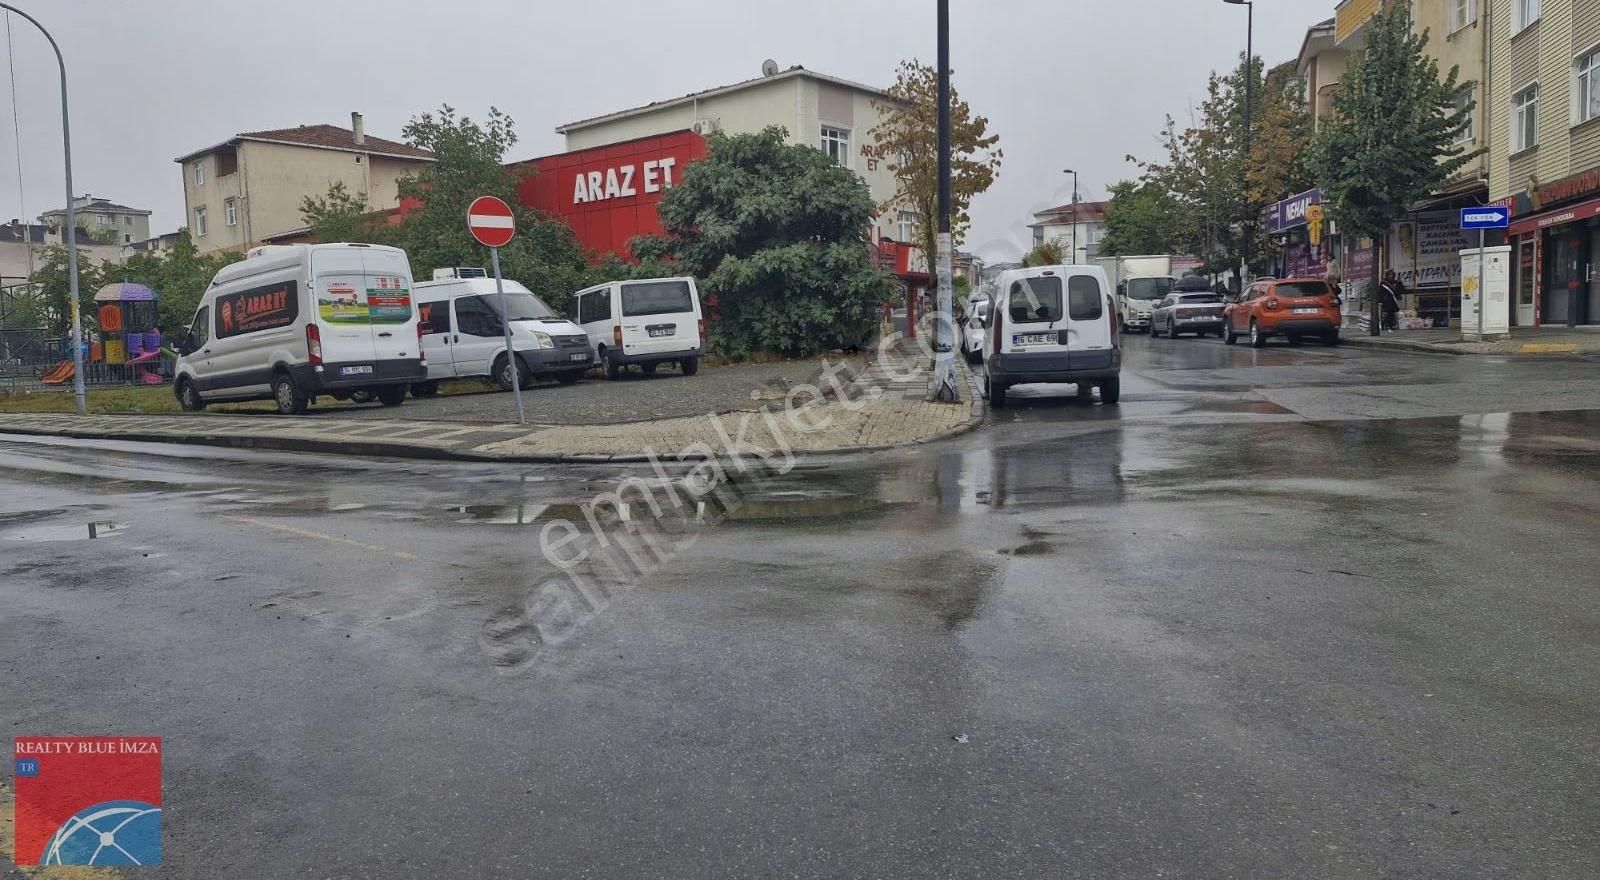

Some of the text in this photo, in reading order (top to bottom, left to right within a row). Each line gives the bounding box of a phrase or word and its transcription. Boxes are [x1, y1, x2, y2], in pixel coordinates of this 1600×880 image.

[867, 159, 879, 171] ET
[573, 157, 676, 204] ARAZ ET
